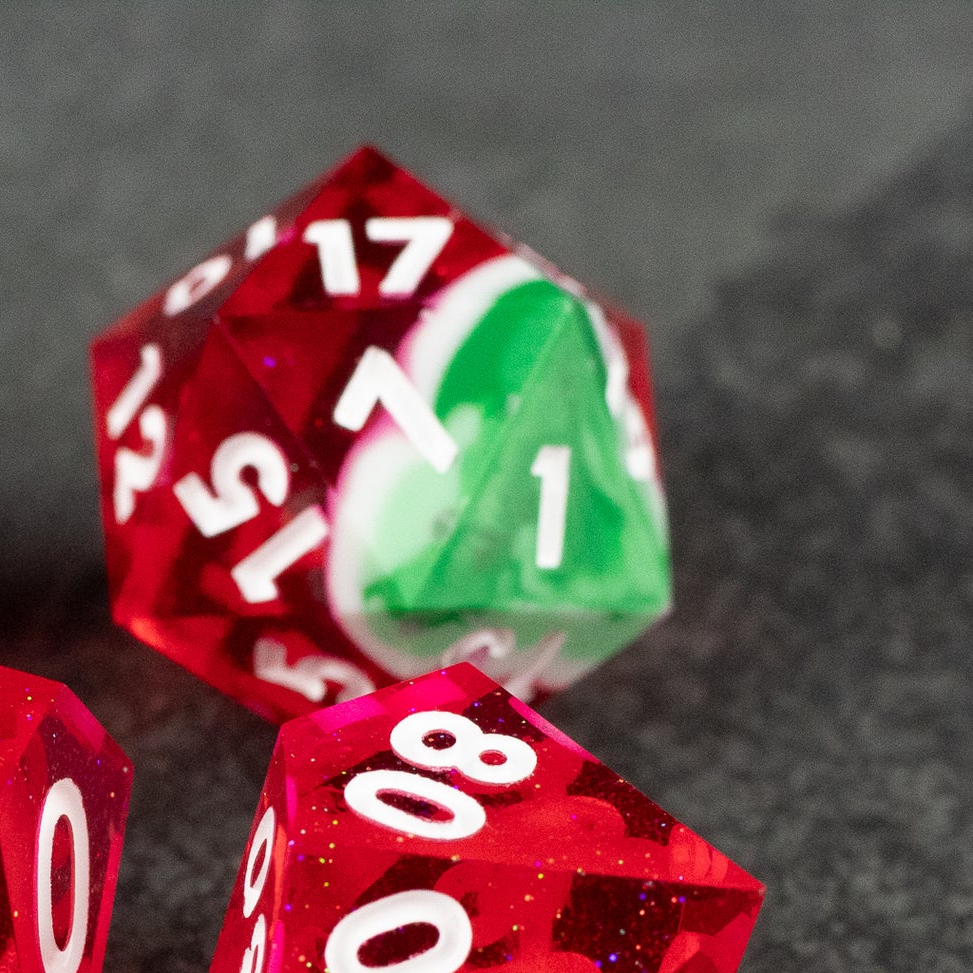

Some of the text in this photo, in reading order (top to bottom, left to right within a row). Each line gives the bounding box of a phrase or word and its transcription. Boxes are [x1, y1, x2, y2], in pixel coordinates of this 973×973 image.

[304, 216, 454, 295] 17
[173, 431, 329, 604] 15
[532, 445, 570, 569] 1
[344, 710, 537, 842] 80
